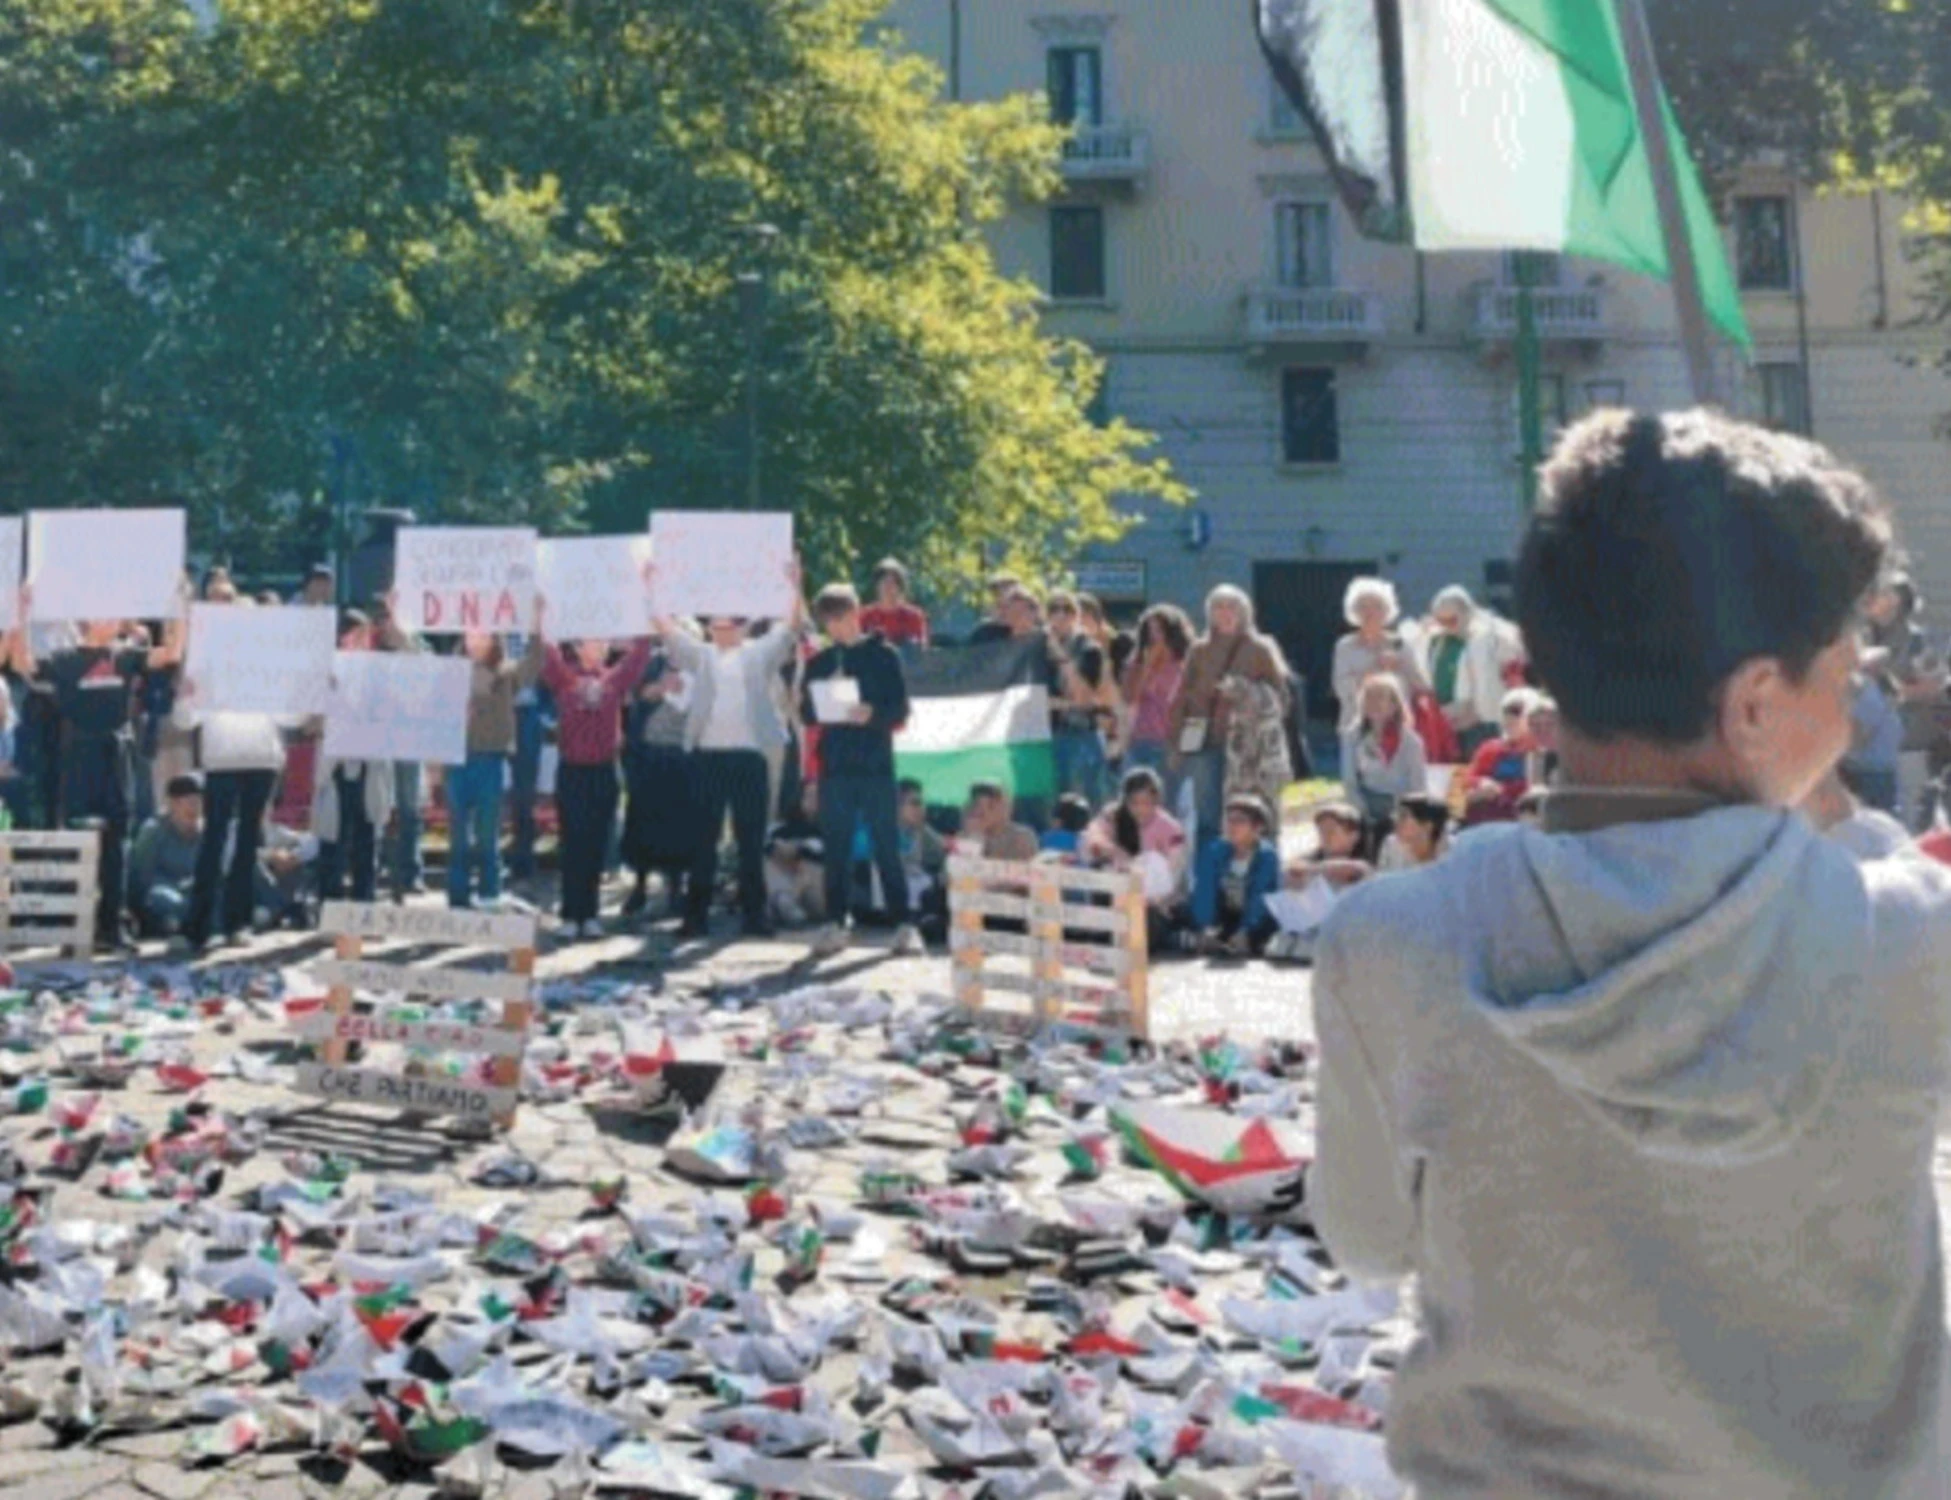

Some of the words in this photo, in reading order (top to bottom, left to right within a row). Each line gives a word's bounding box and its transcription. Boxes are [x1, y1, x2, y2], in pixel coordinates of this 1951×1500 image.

[422, 589, 518, 627] DNA
[318, 1068, 362, 1096] CHE
[376, 1076, 488, 1112] PARTIAMO
